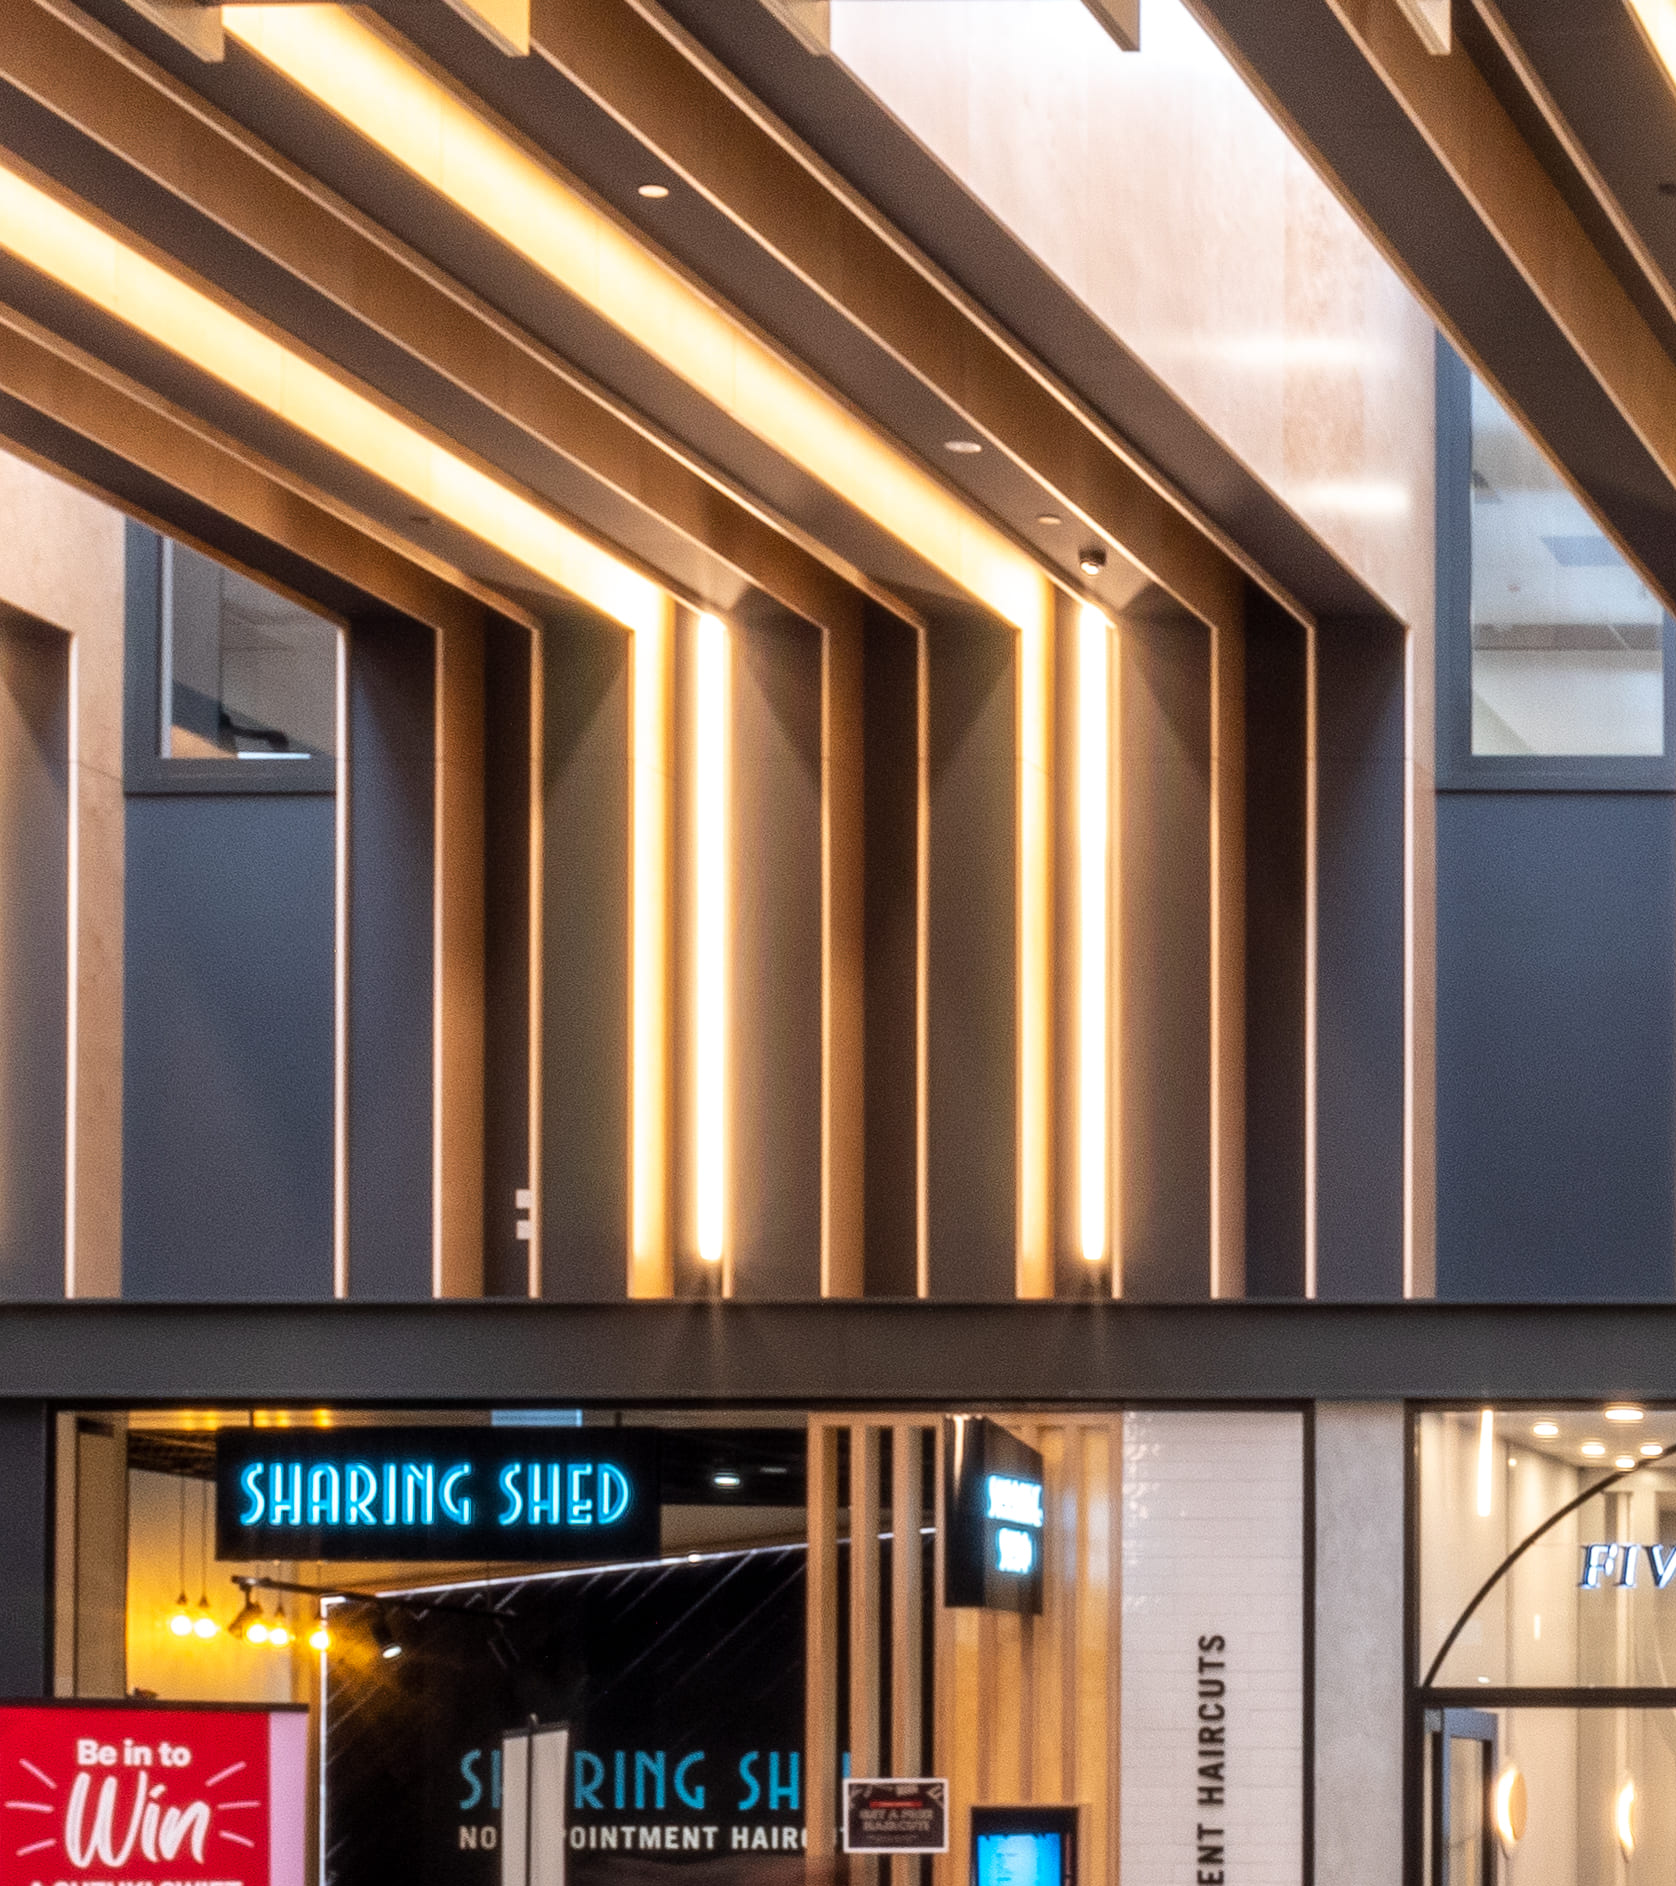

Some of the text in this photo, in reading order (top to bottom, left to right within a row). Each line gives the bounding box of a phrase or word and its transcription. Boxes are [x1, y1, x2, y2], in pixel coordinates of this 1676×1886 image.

[240, 1462, 629, 1525] SHARING SHED
[1197, 1634, 1226, 1806] HAIRCUTS
[76, 1738, 192, 1767] Be in to
[459, 1750, 705, 1810] SRING
[65, 1770, 210, 1868] Win
[459, 1826, 497, 1849] NO
[563, 1826, 719, 1850] OINTMENT
